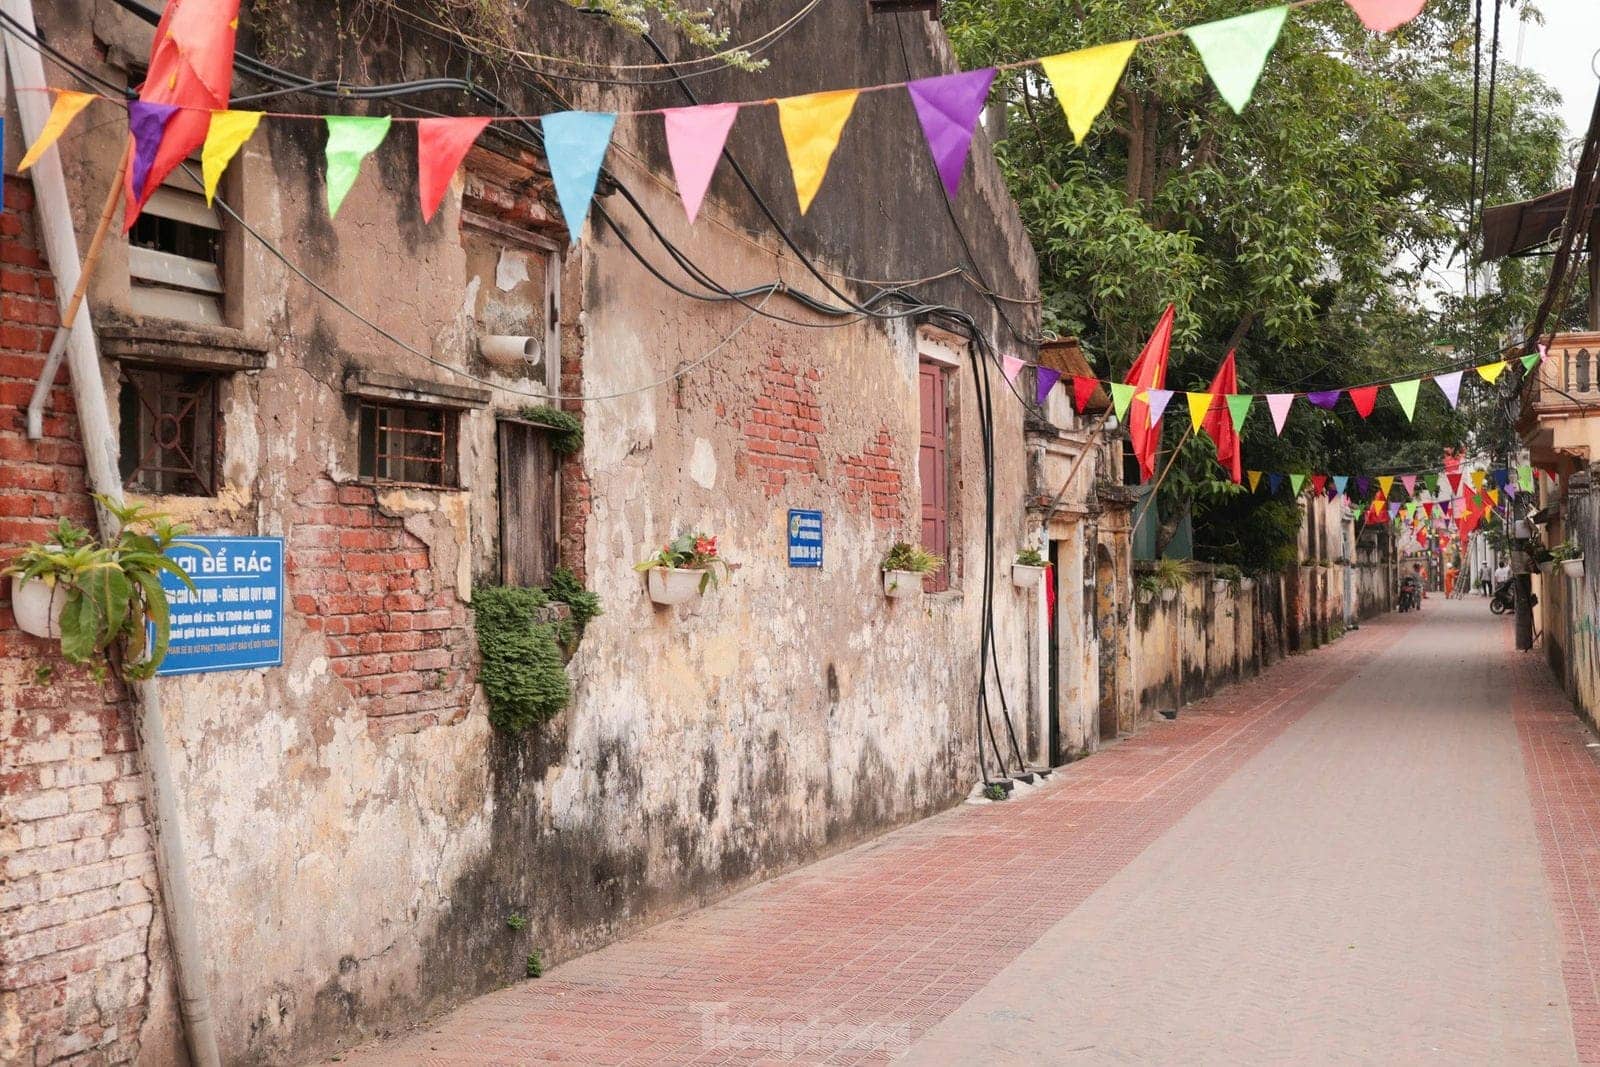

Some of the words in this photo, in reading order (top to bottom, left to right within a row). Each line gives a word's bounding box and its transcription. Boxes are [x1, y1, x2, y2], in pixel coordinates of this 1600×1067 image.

[162, 555, 197, 573] ƠI
[202, 547, 227, 573] ĐỂ
[233, 549, 272, 573] RÁC
